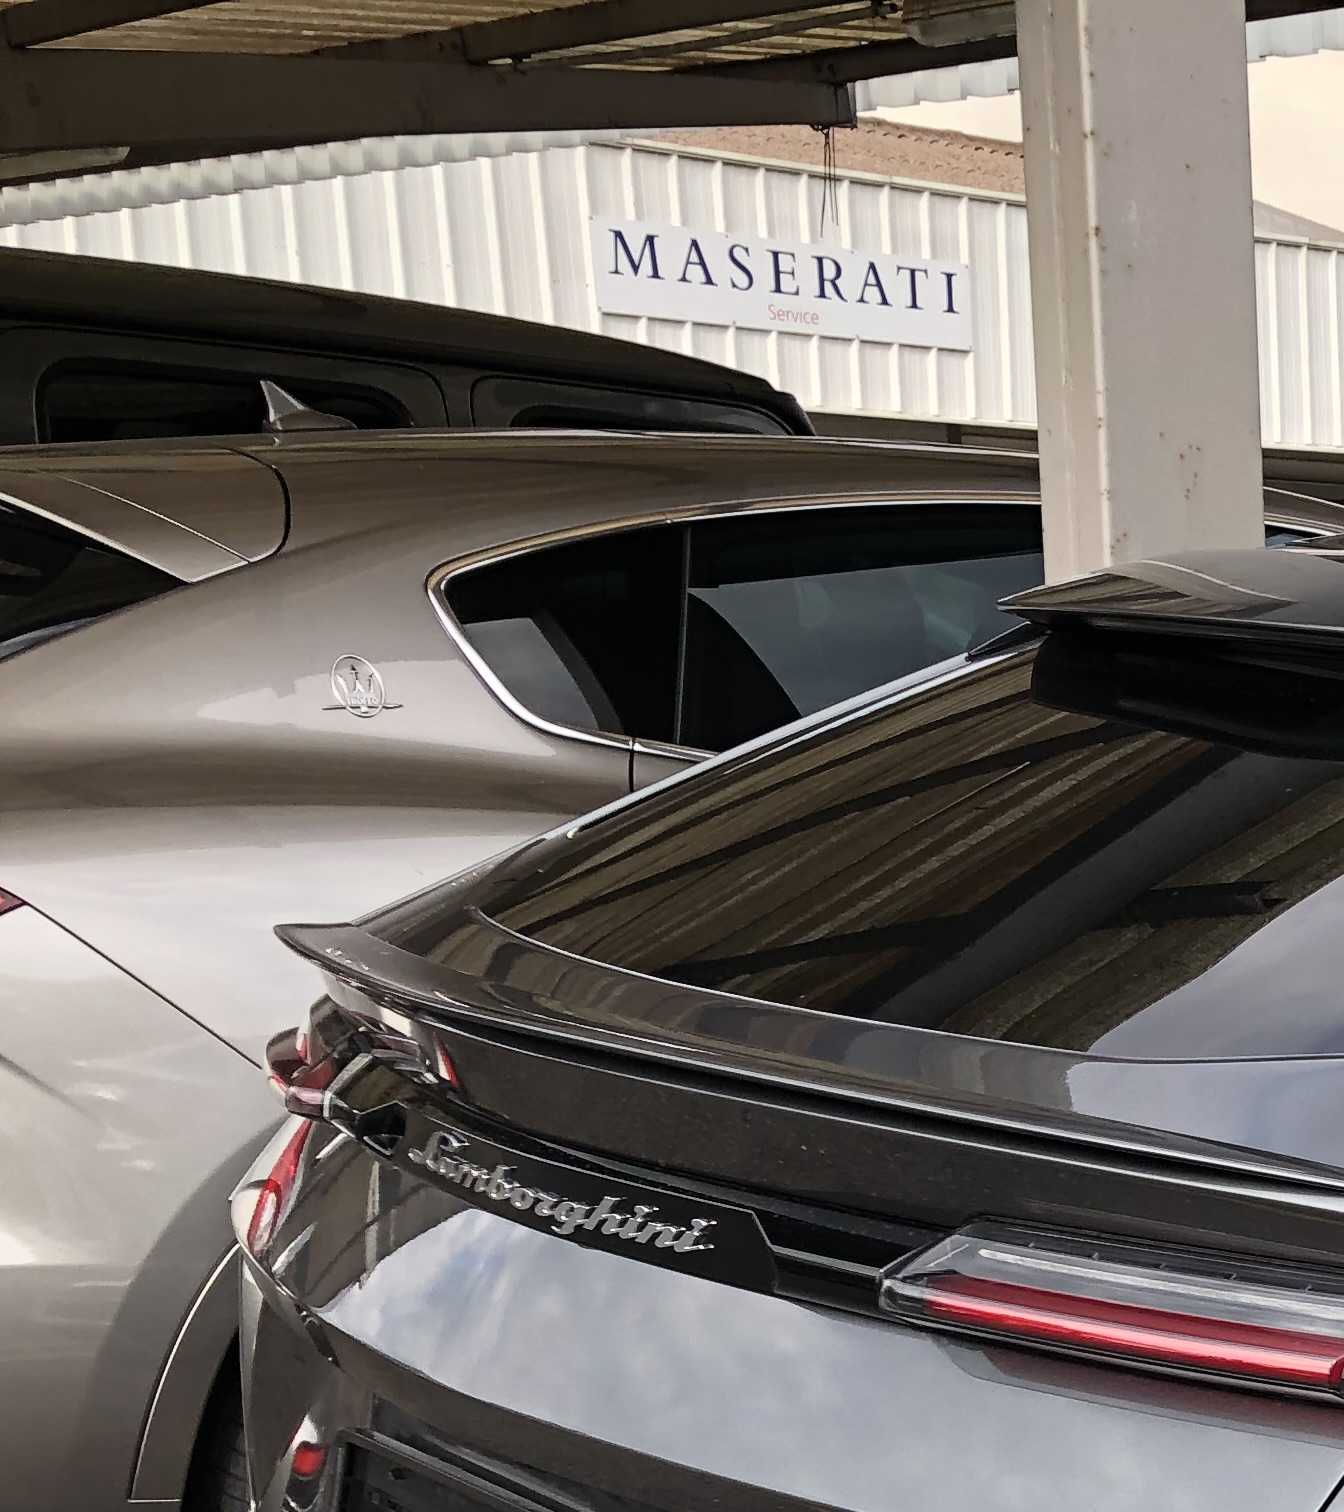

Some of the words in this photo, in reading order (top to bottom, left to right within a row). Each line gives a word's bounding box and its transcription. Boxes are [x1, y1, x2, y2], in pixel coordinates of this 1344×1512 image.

[607, 228, 960, 314] MASERATI
[767, 304, 820, 325] Service
[408, 1130, 718, 1253] Lamborghini
